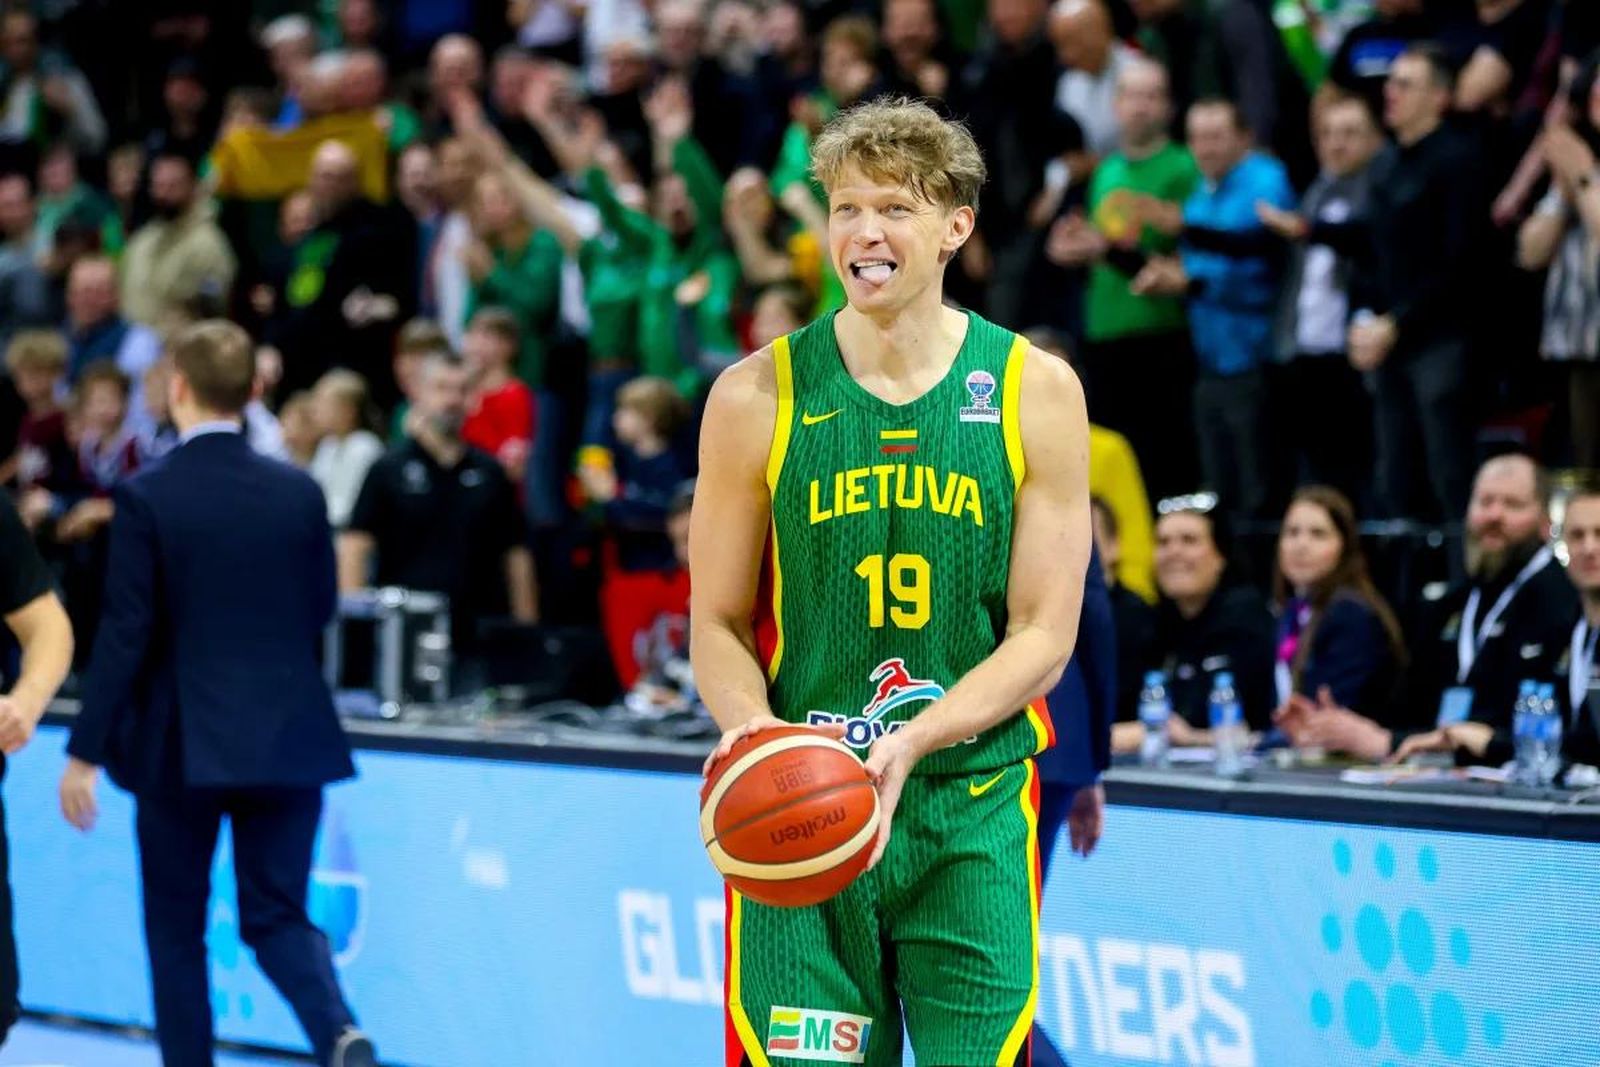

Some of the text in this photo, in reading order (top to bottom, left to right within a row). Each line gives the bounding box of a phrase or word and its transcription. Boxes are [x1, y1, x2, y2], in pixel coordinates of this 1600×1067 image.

[810, 464, 984, 527] LIETUVA
[854, 553, 931, 629] 19
[769, 806, 847, 846] molten
